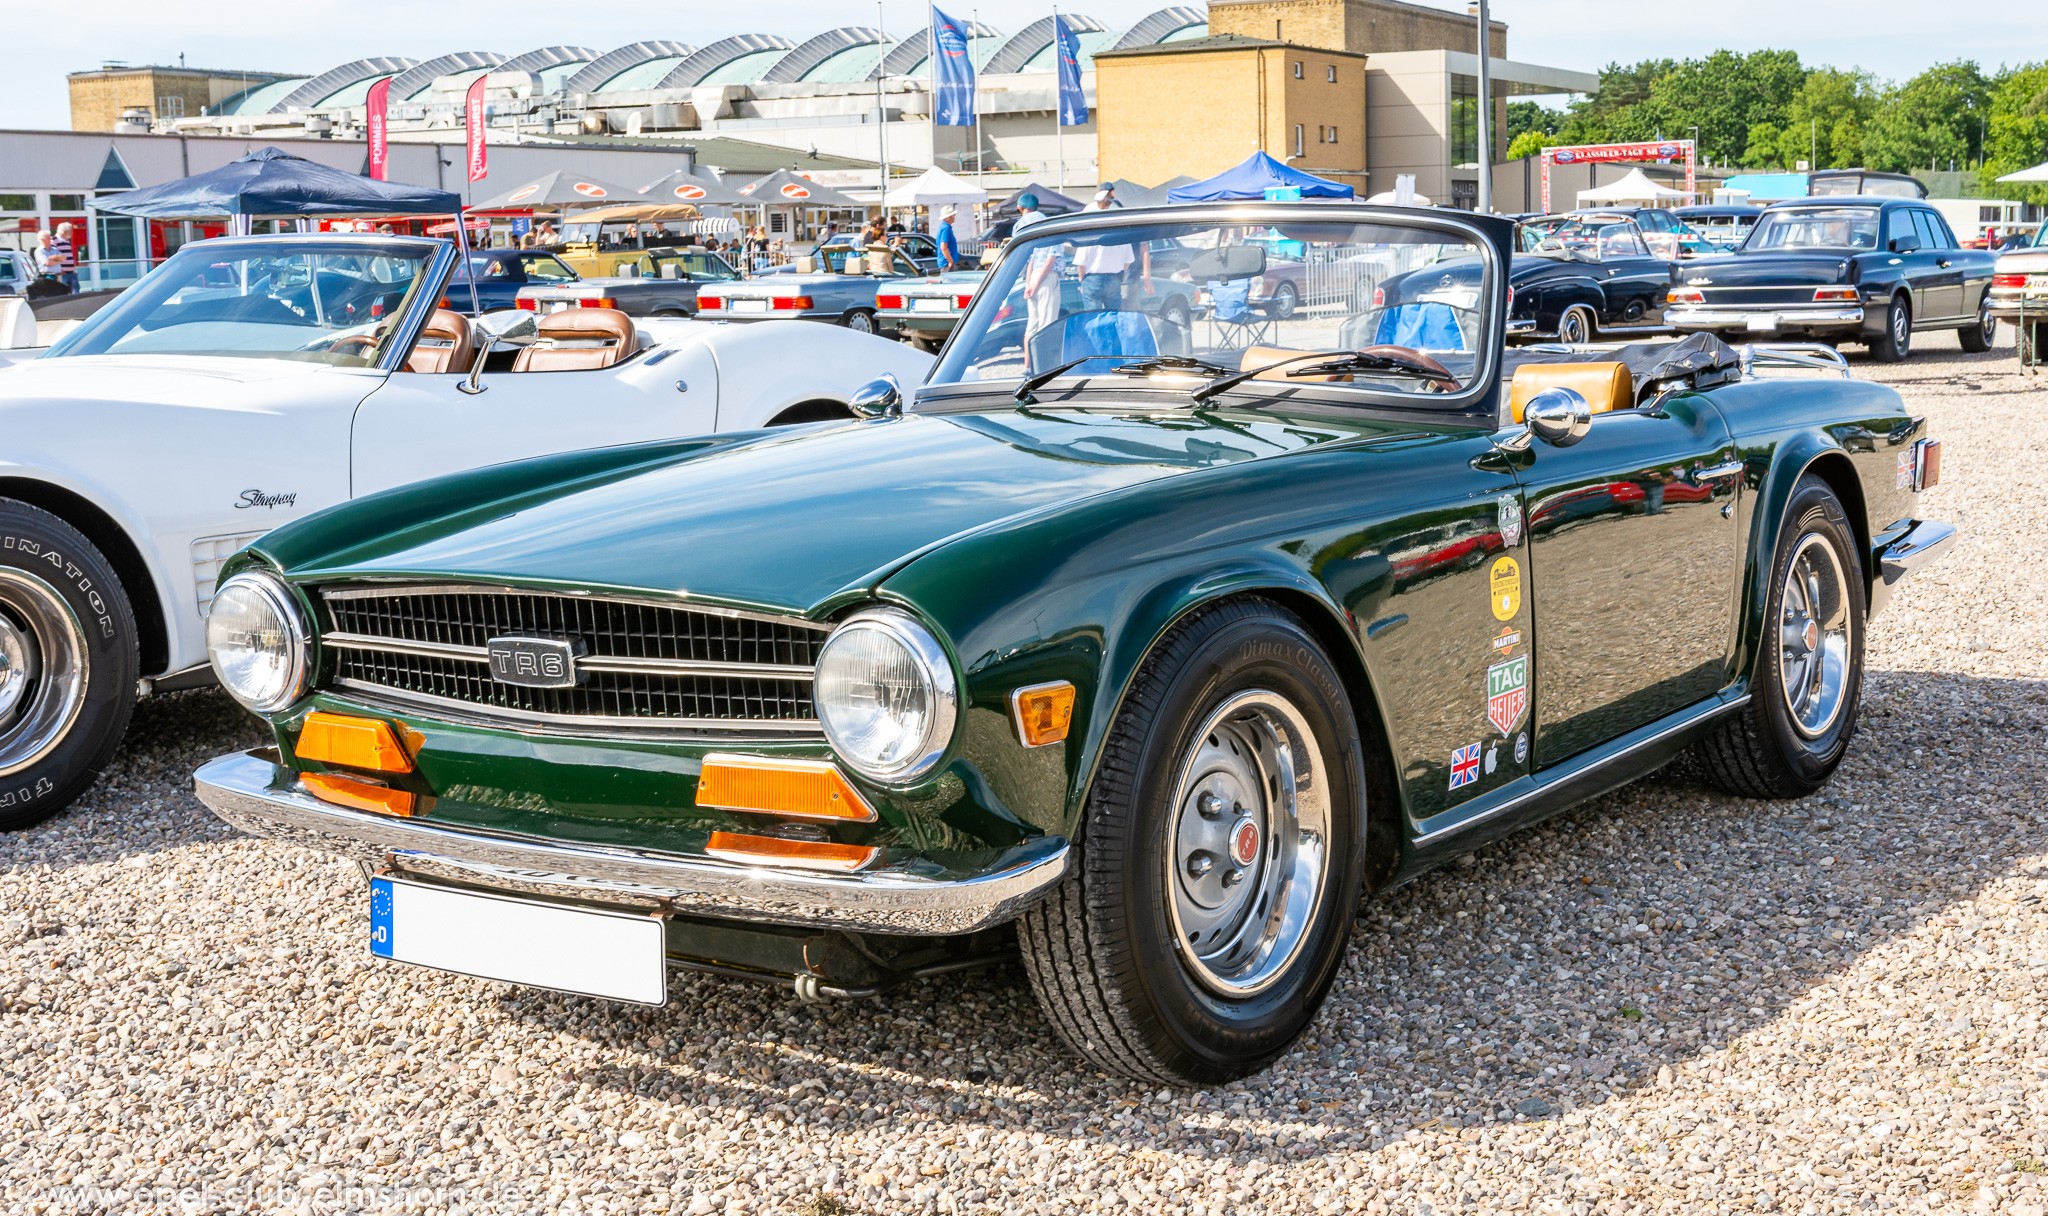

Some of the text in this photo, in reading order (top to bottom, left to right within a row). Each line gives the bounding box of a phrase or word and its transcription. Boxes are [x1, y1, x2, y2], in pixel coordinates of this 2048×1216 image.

[372, 114, 382, 165] POMMES
[472, 98, 484, 174] CURRYWURST
[234, 489, 297, 510] Stingray
[0, 536, 115, 639] INATION
[1494, 632, 1520, 650] MARTINI
[491, 649, 564, 677] TR6
[1240, 639, 1342, 711] Dimax Classic
[1491, 663, 1523, 693] TAG
[1490, 690, 1524, 730] HEUER
[378, 925, 387, 944] D
